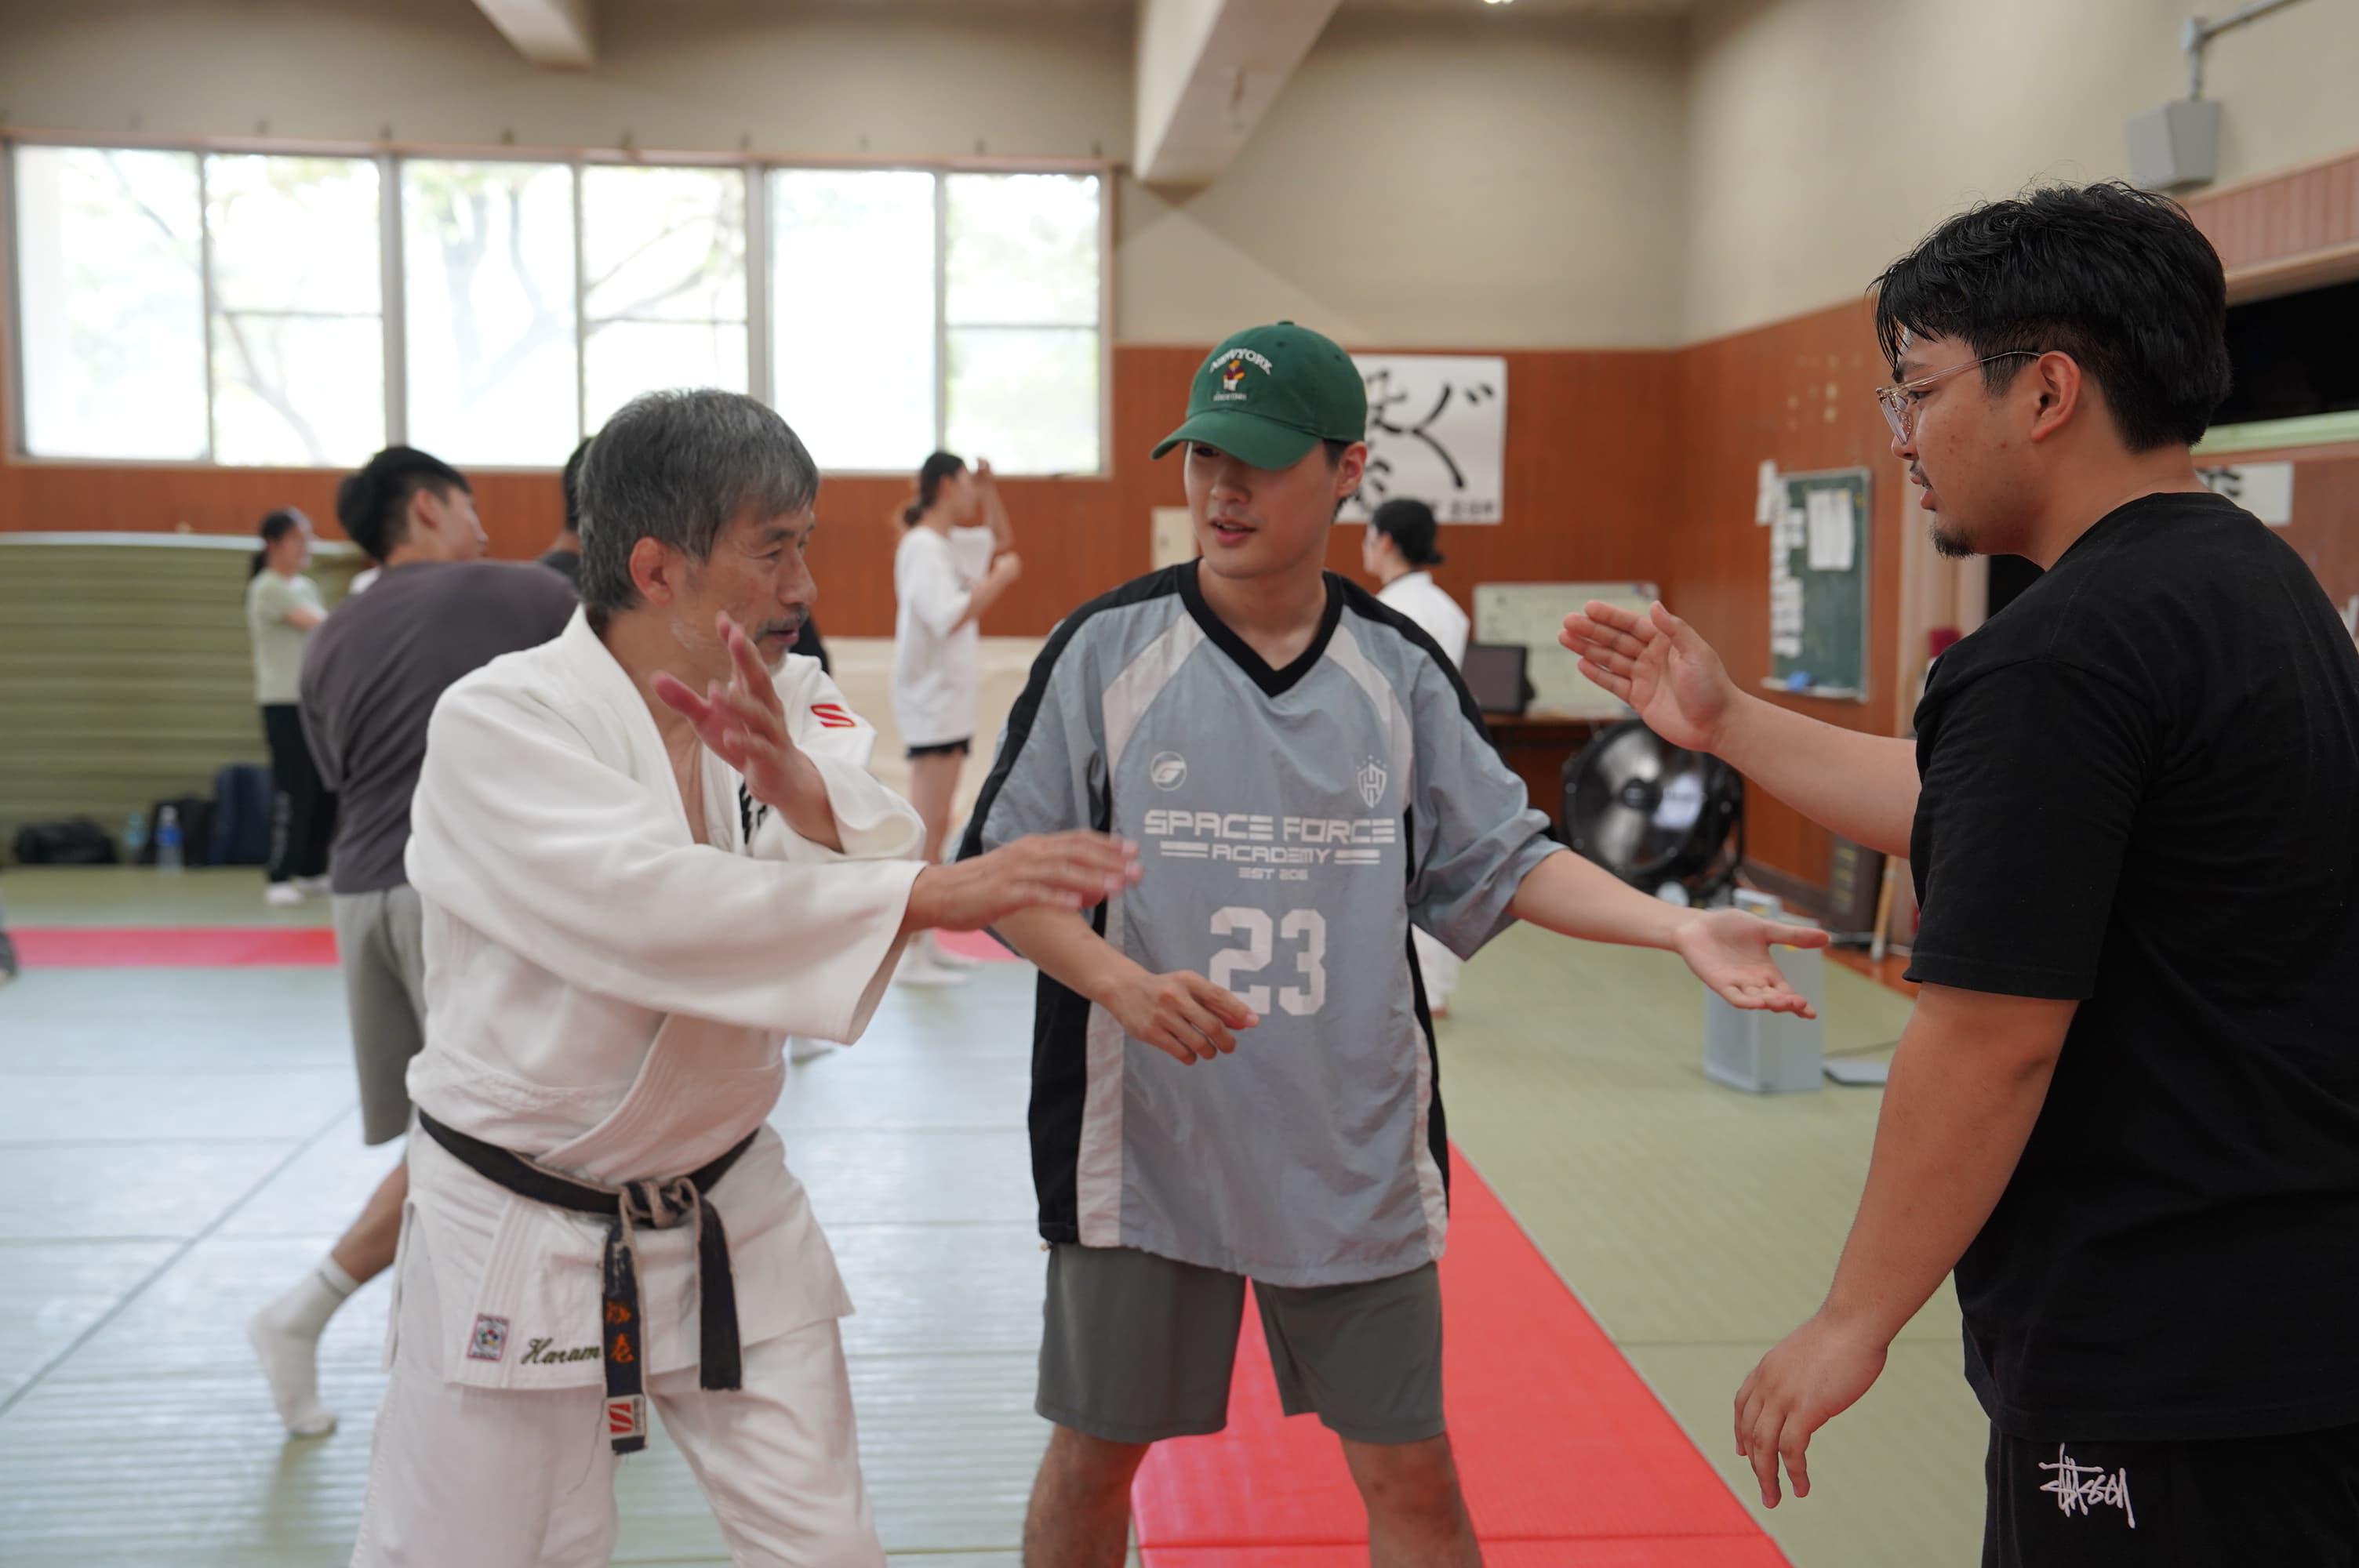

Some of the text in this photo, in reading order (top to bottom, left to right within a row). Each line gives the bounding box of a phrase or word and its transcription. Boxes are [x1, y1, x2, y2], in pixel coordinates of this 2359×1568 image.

[1144, 809, 1395, 844] SPACE FORCE
[1212, 842, 1330, 865] ACADEMY
[1238, 866, 1274, 880] EST
[1209, 906, 1326, 1016] 23
